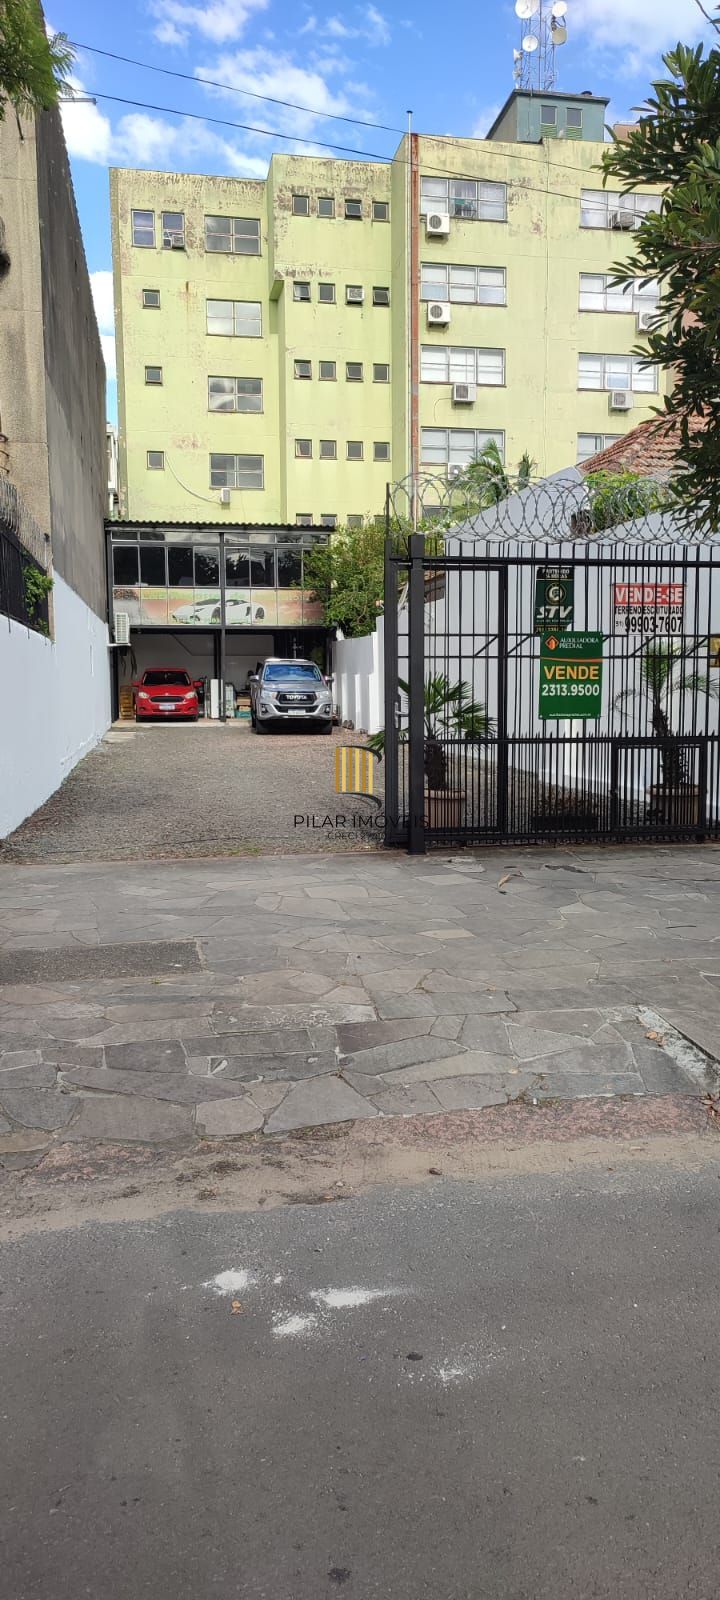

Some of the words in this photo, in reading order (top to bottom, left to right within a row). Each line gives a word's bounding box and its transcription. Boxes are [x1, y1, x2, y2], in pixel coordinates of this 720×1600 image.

[615, 587, 683, 603] VENDE-SE
[536, 605, 573, 619] STV
[643, 606, 684, 615] ESCITUADO
[625, 616, 683, 633] 99903-7607
[543, 665, 600, 680] VENDE
[541, 684, 600, 697] 2313.9500
